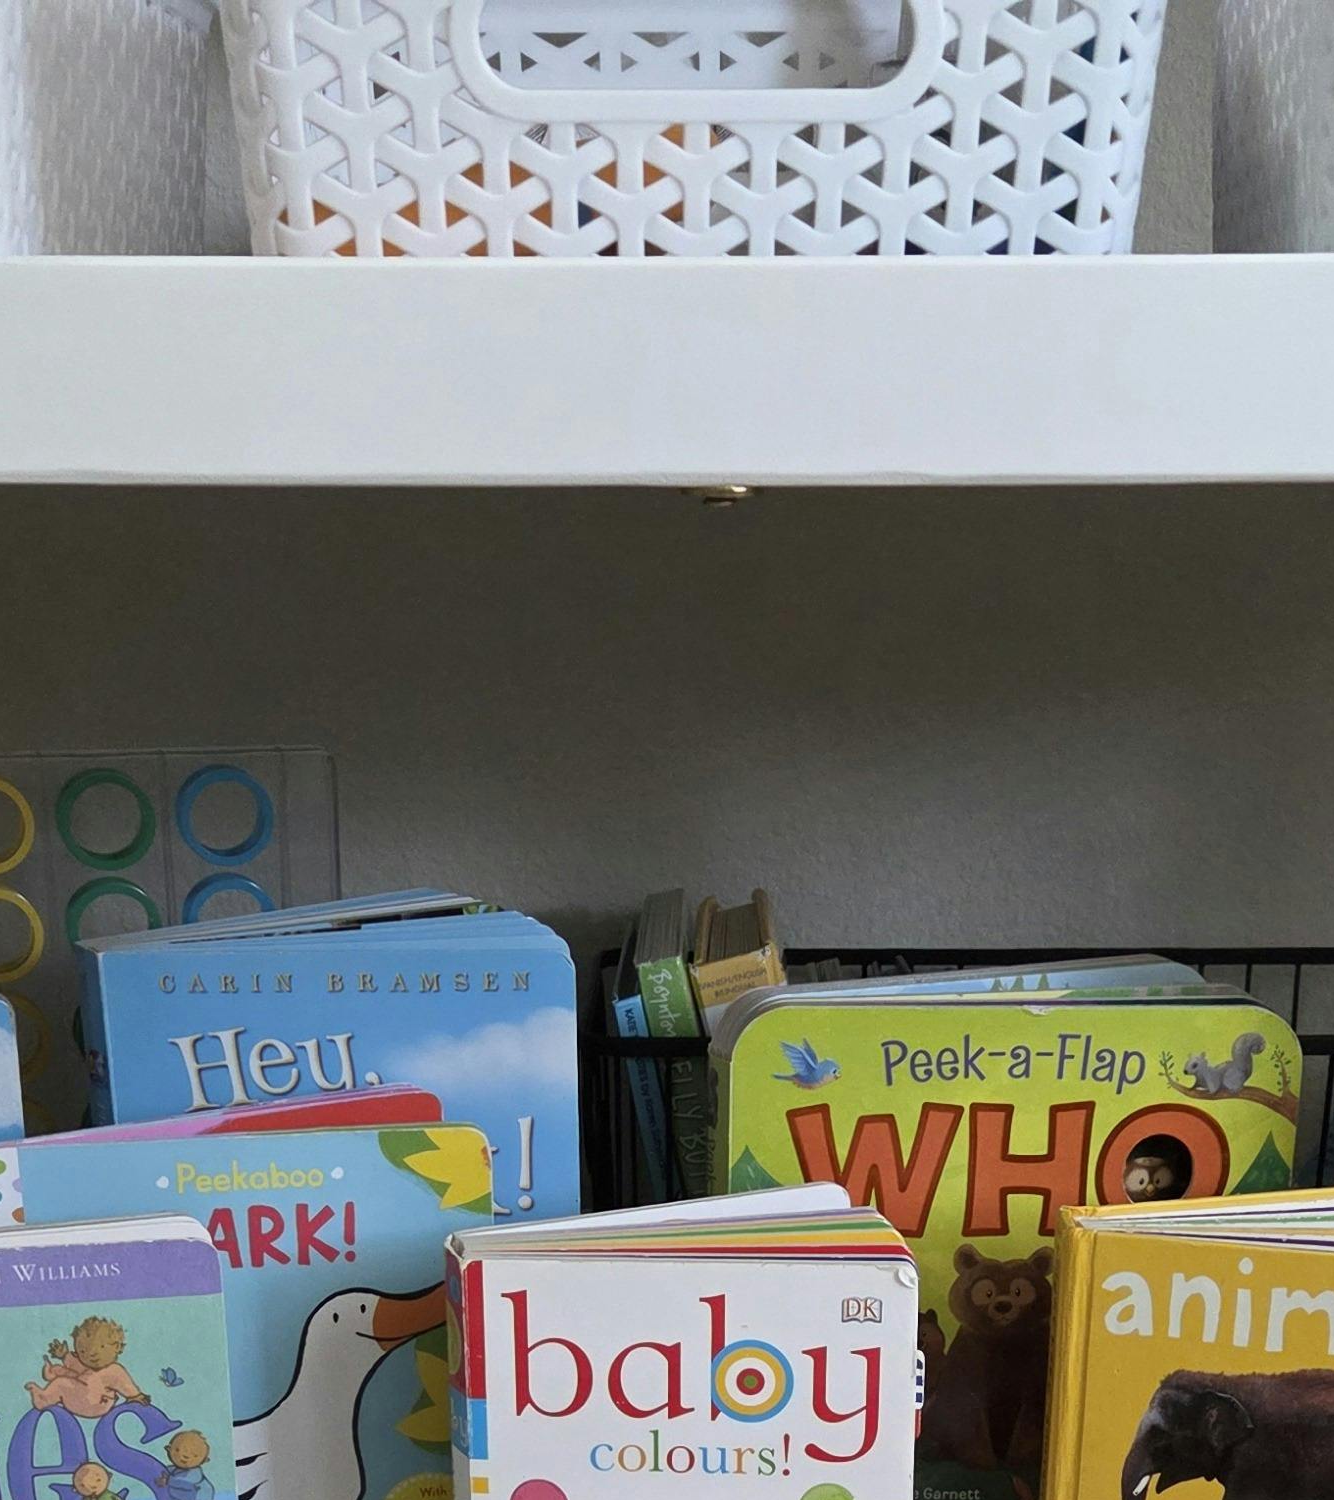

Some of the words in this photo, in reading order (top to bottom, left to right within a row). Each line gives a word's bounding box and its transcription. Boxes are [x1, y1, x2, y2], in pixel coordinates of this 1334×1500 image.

[158, 971, 293, 994] CARIN
[327, 970, 533, 994] BRAMSEN
[881, 1033, 1147, 1094] Peek-a-Flap
[176, 1160, 325, 1194] Peekaboo
[786, 1100, 1231, 1239] WHO
[207, 1201, 357, 1269] ARK!
[845, 1298, 880, 1321] DK
[501, 1290, 882, 1463] baby
[589, 1429, 792, 1479] colours!
[922, 1487, 981, 1500] Garnett
